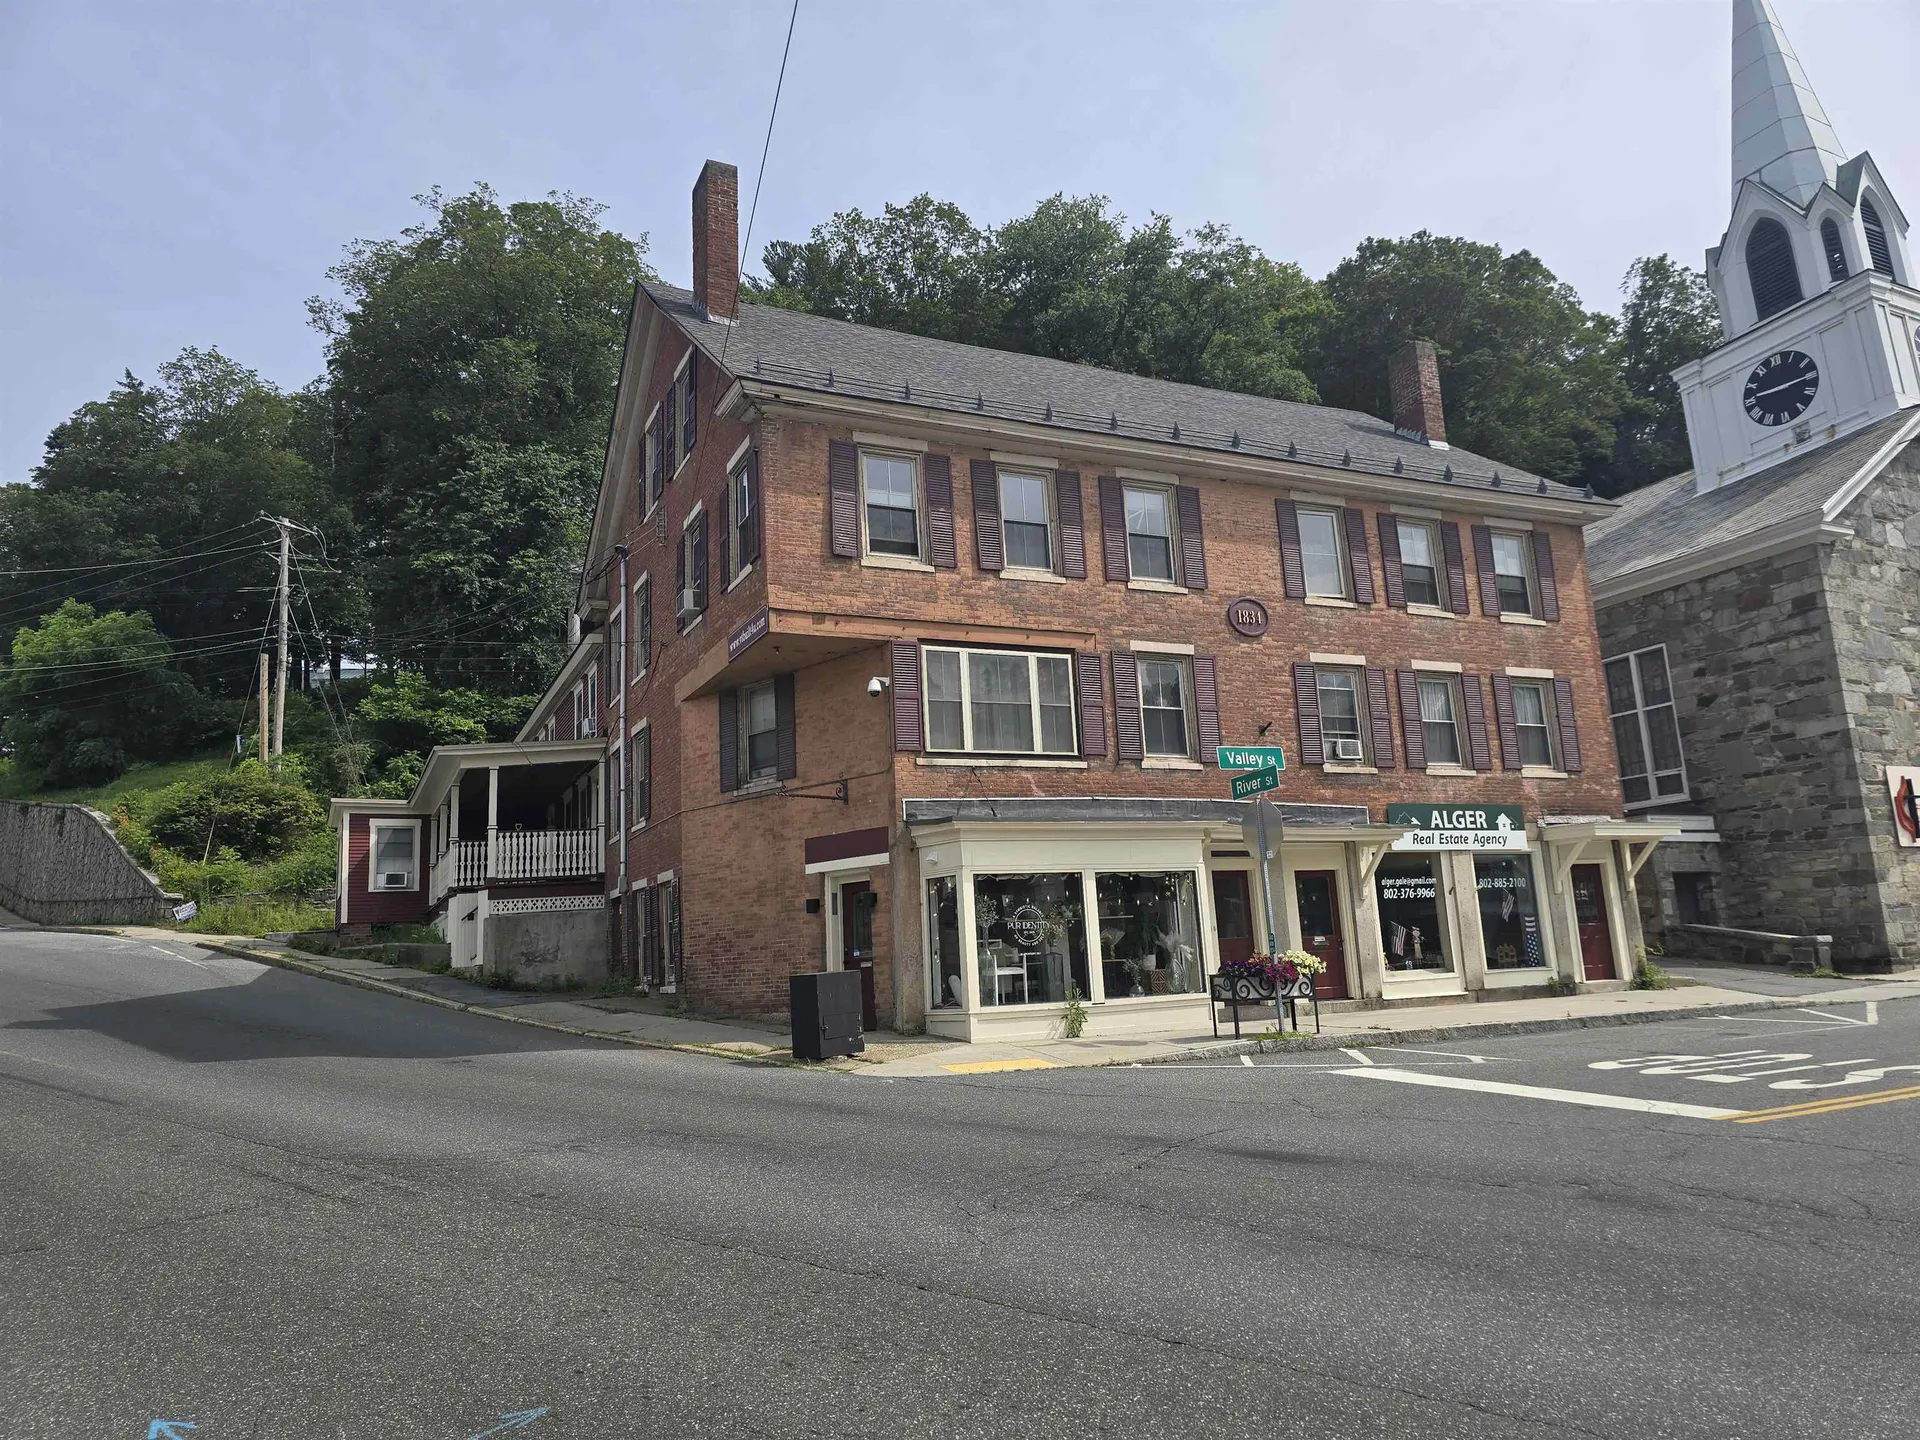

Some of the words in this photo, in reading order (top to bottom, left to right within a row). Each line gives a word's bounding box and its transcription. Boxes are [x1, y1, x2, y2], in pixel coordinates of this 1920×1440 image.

[1770, 354, 1782, 367] XII
[1237, 610, 1262, 624] 1834
[1226, 752, 1263, 768] Valley
[1267, 756, 1276, 765] St
[1236, 778, 1261, 794] River
[1266, 776, 1273, 786] St
[1431, 810, 1488, 829] ALGER
[1413, 833, 1434, 844] Real
[1440, 833, 1468, 844] Estate
[1473, 833, 1508, 847] Agency
[1479, 878, 1526, 888] 802-885-2100
[1384, 888, 1435, 899] 802-376-9966
[1007, 922, 1021, 930] PUR
